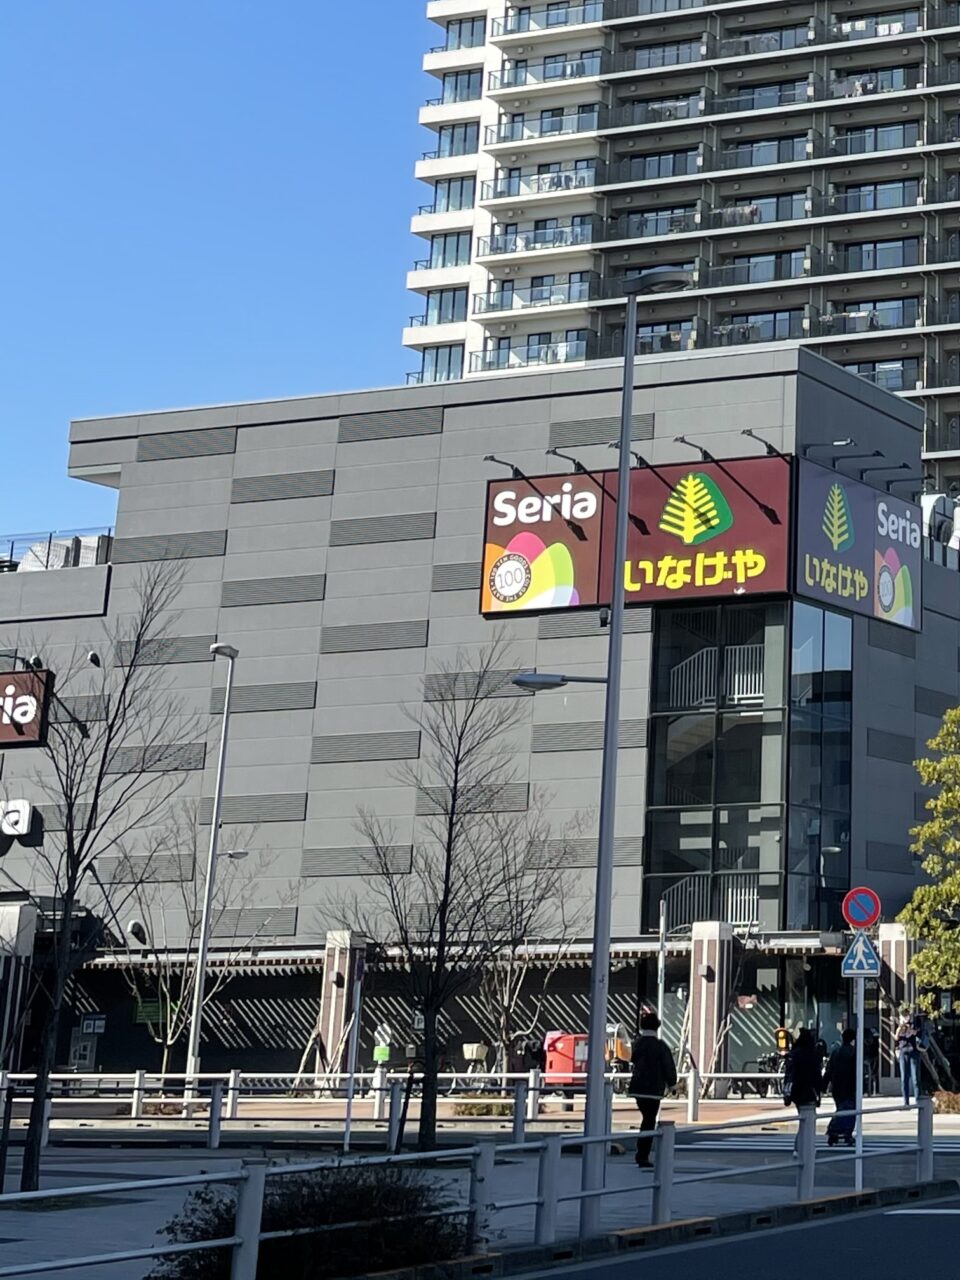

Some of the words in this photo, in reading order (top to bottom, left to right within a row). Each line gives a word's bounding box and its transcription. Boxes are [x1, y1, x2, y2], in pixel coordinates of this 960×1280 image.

[493, 482, 597, 526] Seria
[877, 502, 920, 549] Seria
[497, 567, 523, 589] 100
[624, 549, 766, 591] いなげや
[805, 553, 869, 601] いなげや
[0, 684, 38, 724] ia
